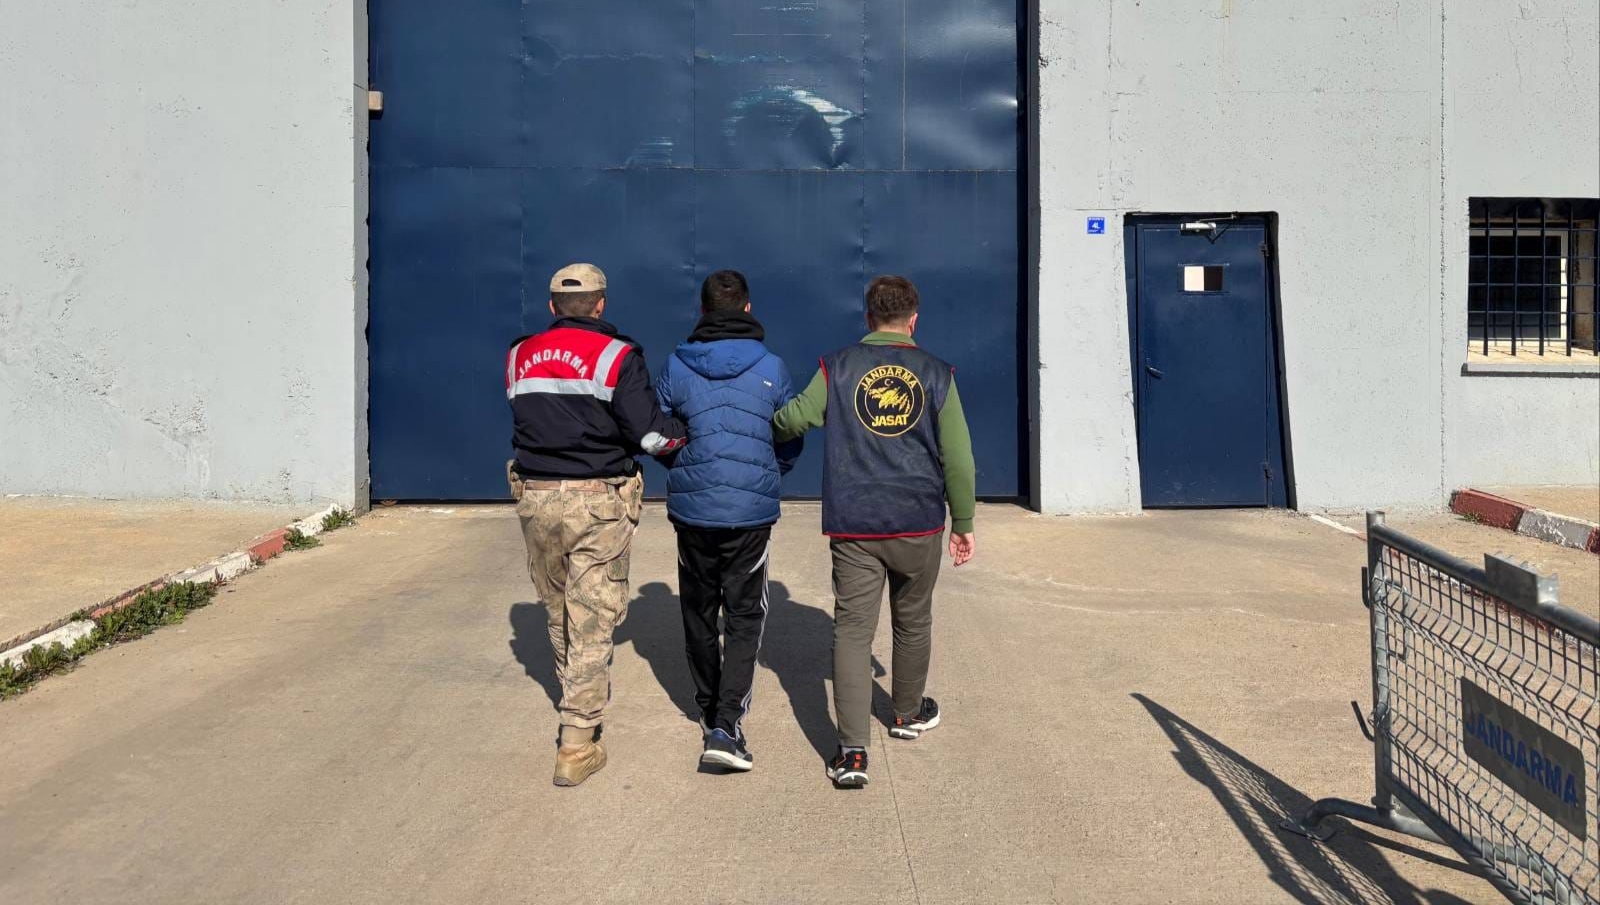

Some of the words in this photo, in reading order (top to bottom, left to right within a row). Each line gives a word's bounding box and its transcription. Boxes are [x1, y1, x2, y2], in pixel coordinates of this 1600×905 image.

[518, 348, 589, 379] JANDARMA
[861, 367, 918, 391] JANDARMA
[871, 414, 909, 427] JASAT
[1465, 709, 1578, 807] JANDARMA
